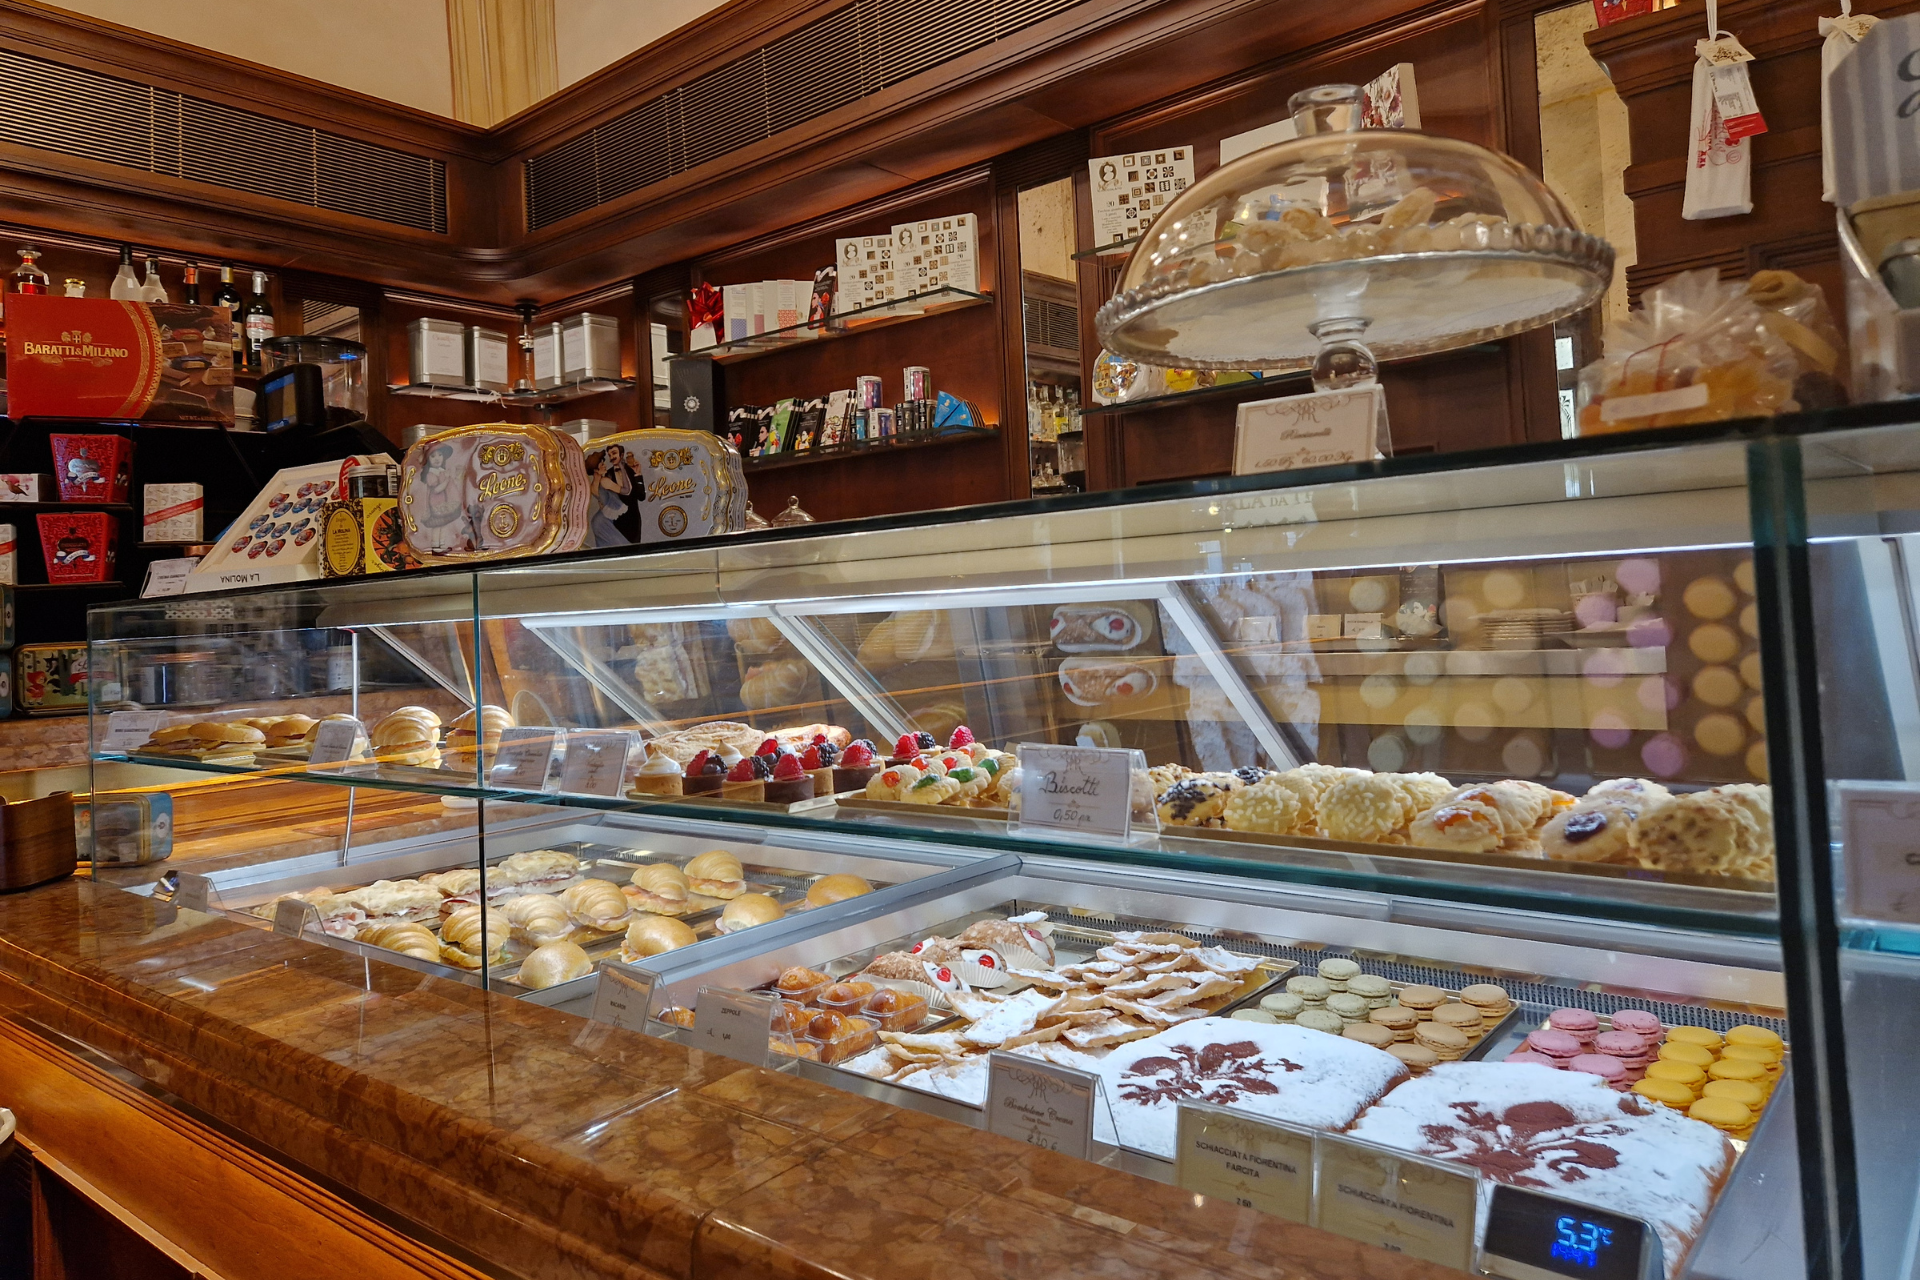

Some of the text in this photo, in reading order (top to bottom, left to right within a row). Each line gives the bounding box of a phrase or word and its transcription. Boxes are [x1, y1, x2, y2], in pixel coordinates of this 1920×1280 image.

[24, 341, 129, 358] BARATTI&MILANO
[478, 472, 527, 501] Leone
[647, 474, 697, 502] Leone
[220, 573, 260, 583] LA MOLINA
[1039, 771, 1100, 797] Biscotti
[1053, 808, 1078, 823] 0,50
[720, 1007, 742, 1017] ZEPPOLE
[1003, 1096, 1045, 1117] Bombolone
[1225, 1162, 1260, 1179] FARCITA
[1249, 1154, 1298, 1175] FIORENTINA
[1337, 1183, 1456, 1228] SCHIACCIATA FIORENTINA
